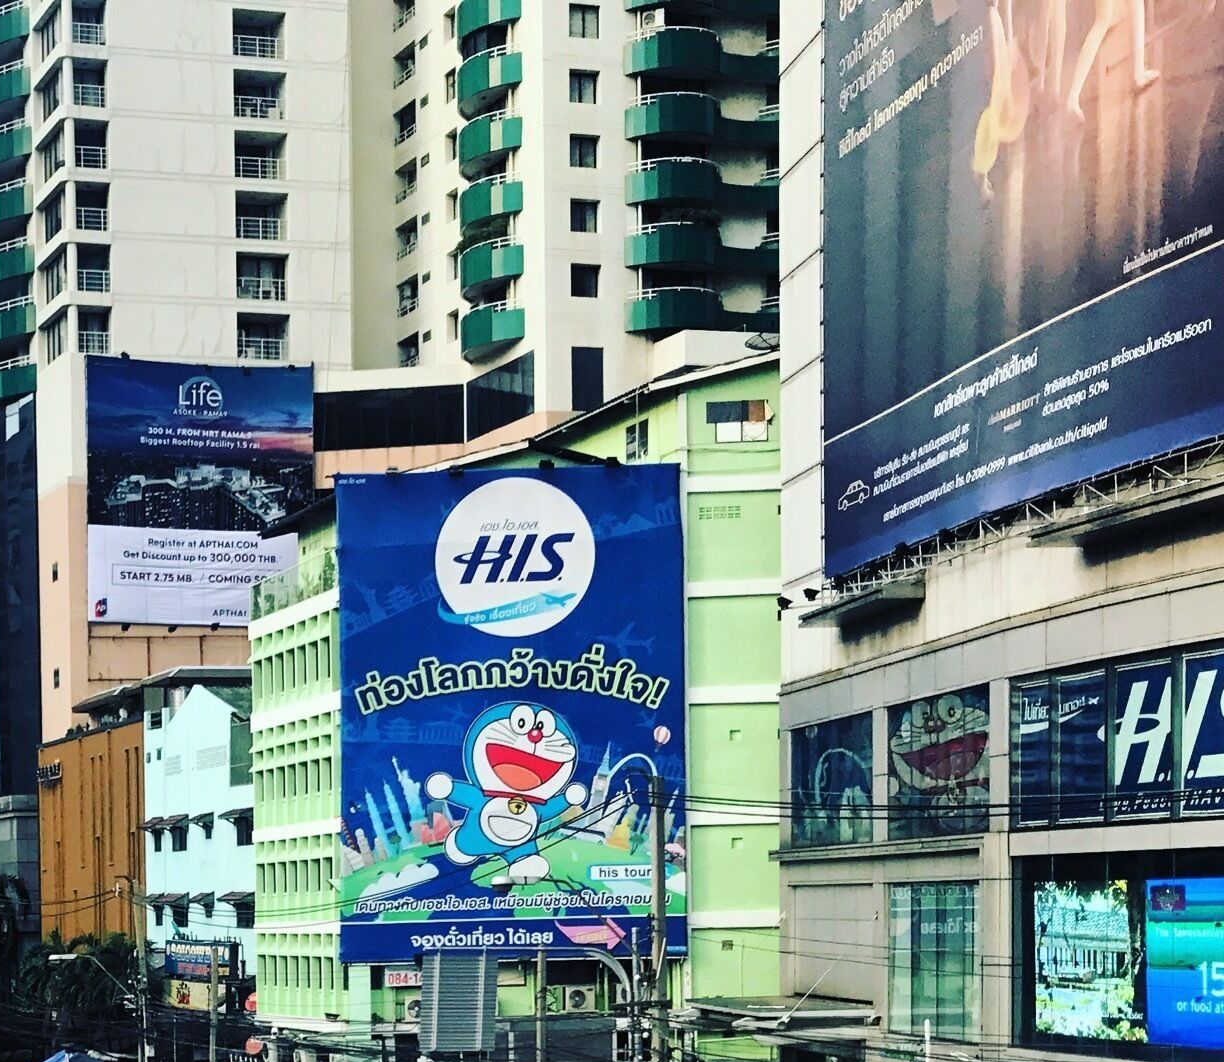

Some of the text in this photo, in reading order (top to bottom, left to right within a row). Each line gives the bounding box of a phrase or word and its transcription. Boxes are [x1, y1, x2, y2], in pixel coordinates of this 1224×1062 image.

[178, 381, 223, 407] Life
[1088, 377, 1110, 399] 50%
[173, 408, 197, 416] ASOKE
[148, 426, 164, 435] 300
[177, 428, 201, 437] FROM
[202, 429, 220, 438] MRT
[139, 436, 170, 446] Biggest
[172, 437, 205, 448] Rooftop
[206, 439, 234, 450] Facility
[236, 440, 248, 449] 1.5
[1007, 416, 1108, 467] www.citibank.co.th/citigold
[148, 538, 185, 549] Register
[187, 540, 197, 548] at
[123, 550, 139, 559] Get
[141, 551, 181, 561] Discount
[183, 555, 196, 563] up
[197, 554, 207, 562] to
[209, 553, 256, 564] 300,000
[453, 532, 575, 585] H.I.S.
[120, 571, 152, 581] START
[154, 573, 174, 583] 2.75
[208, 574, 252, 584] COMING
[354, 644, 670, 715] ท่องโลกกว้างดั่งใจ!
[598, 867, 619, 878] his
[410, 926, 505, 948] จองตั๋วเที่ยว
[507, 928, 554, 945] ได้เลย
[1177, 1001, 1187, 1011] or
[1191, 999, 1212, 1013] food
